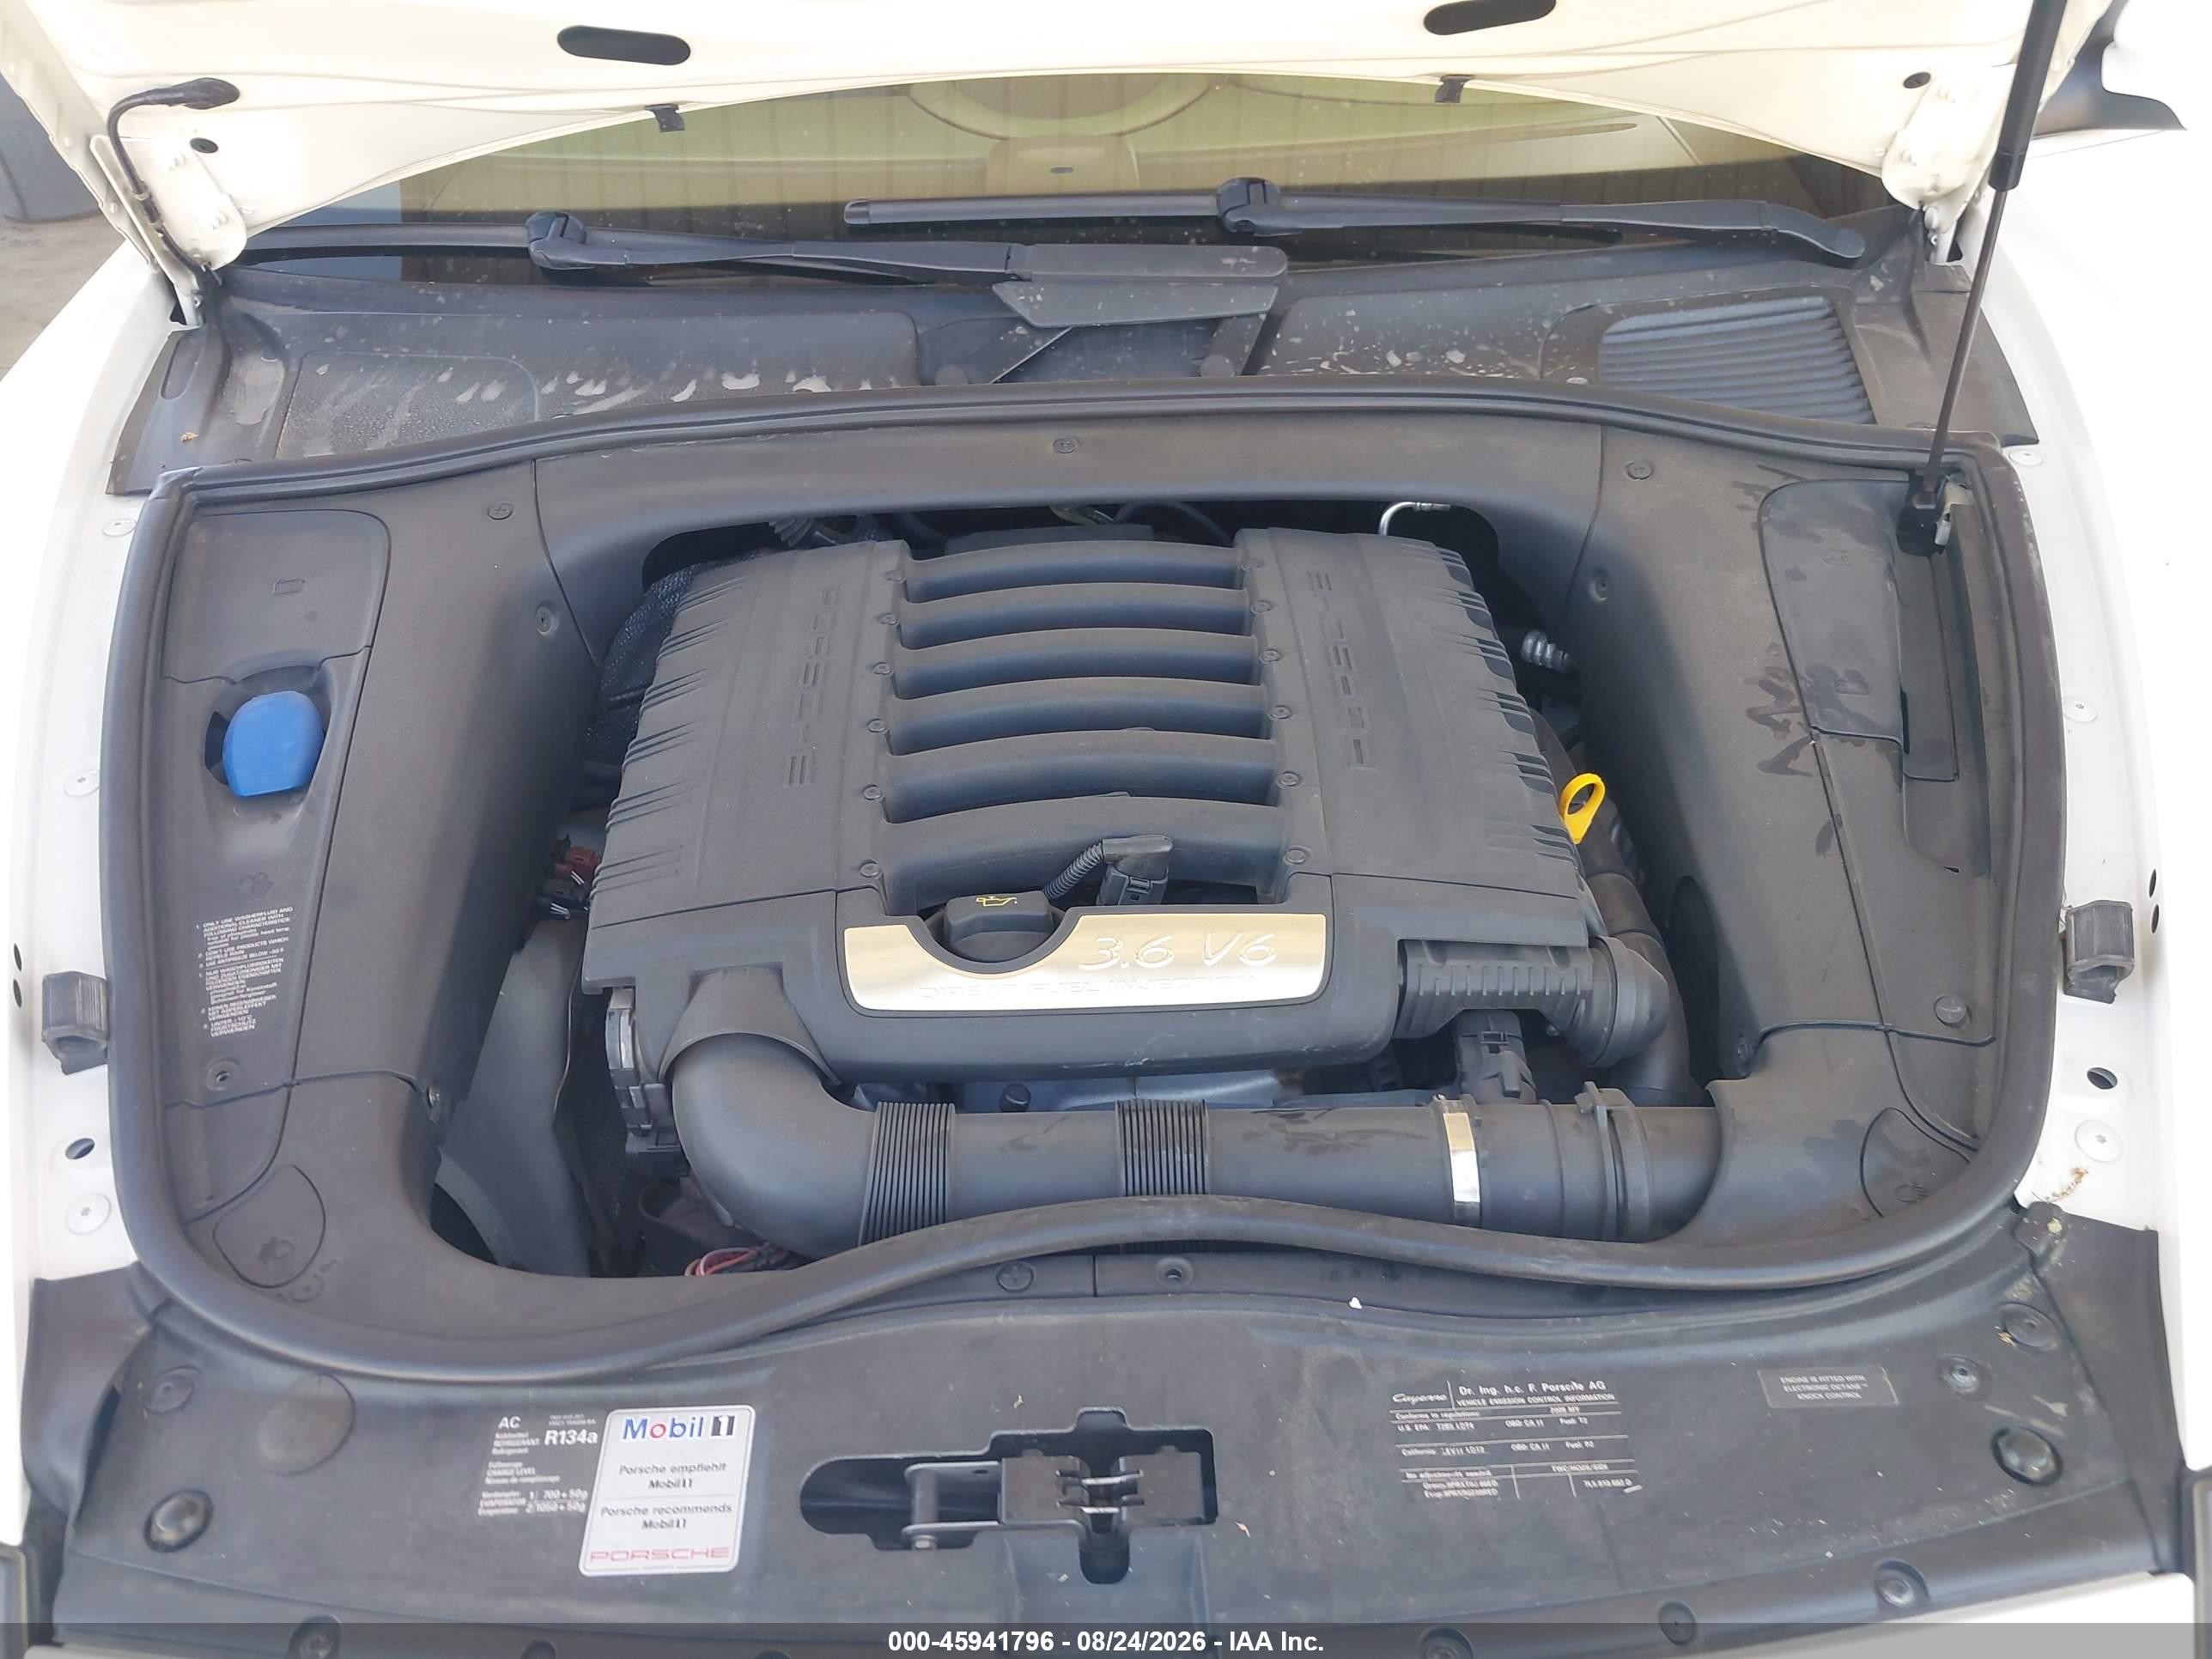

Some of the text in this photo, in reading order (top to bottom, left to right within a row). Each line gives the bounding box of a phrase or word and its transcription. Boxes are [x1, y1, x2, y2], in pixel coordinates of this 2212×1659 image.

[1078, 933, 1279, 971] 3.6 V6
[1589, 1380, 1607, 1391] AG
[1527, 1395, 1563, 1405] CONTROL
[1563, 1393, 1616, 1403] INFORMATION
[497, 1415, 521, 1430] AC
[622, 1414, 736, 1440] Mobil 1
[544, 1428, 599, 1446] R134a
[619, 1462, 726, 1475] Porsche empfiehlt
[600, 1503, 732, 1517] Porsche recommends
[590, 1547, 730, 1563] PORSCHE
